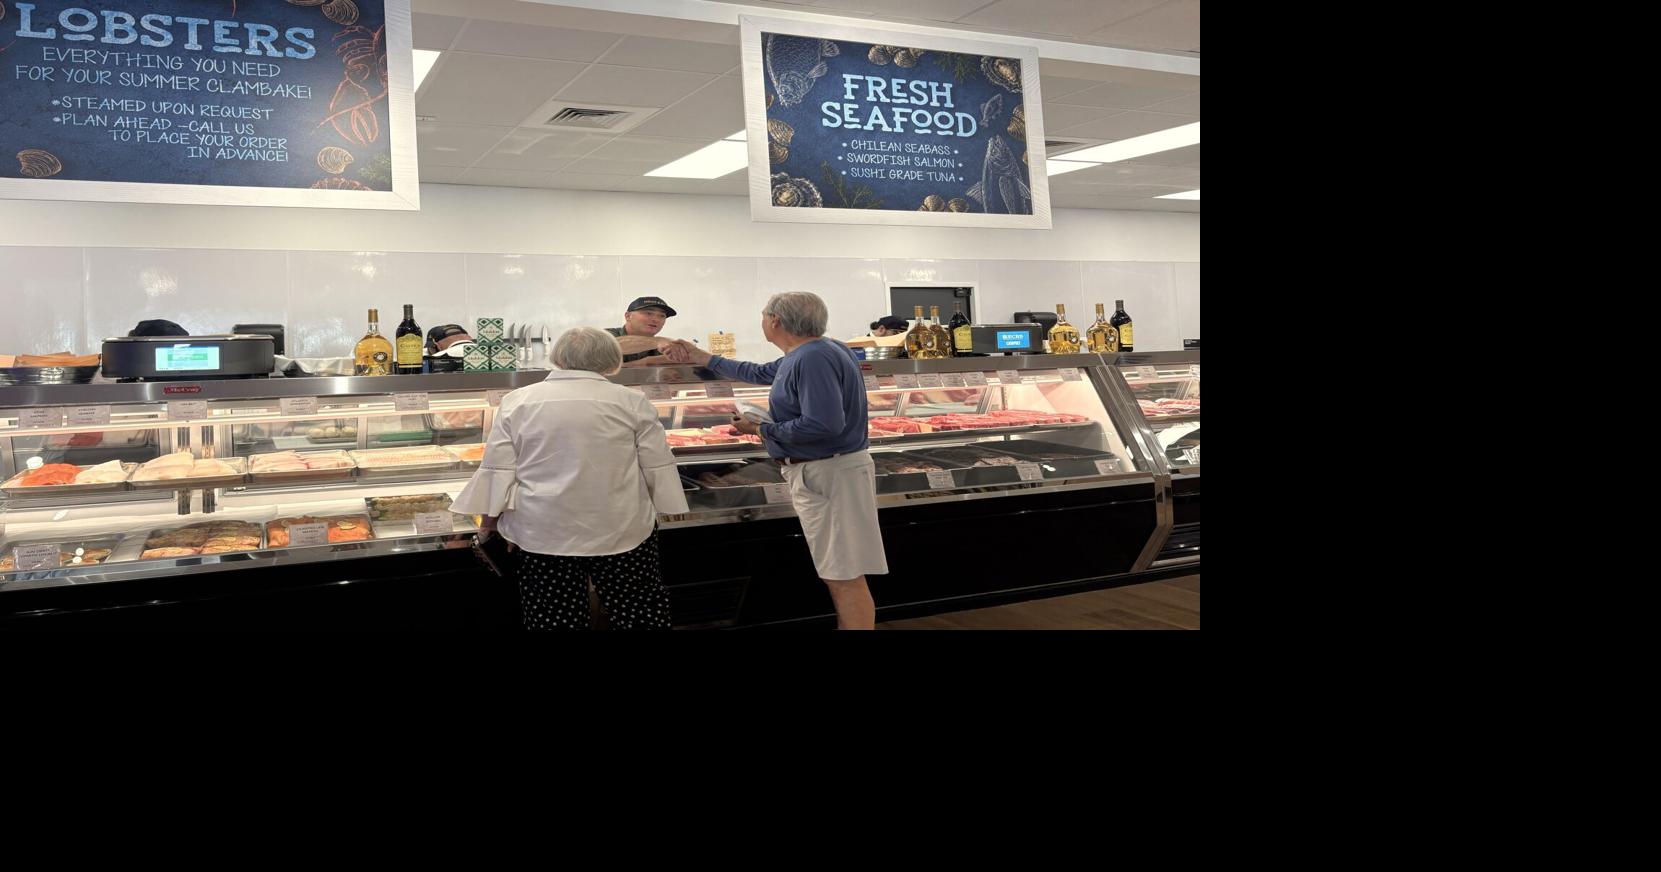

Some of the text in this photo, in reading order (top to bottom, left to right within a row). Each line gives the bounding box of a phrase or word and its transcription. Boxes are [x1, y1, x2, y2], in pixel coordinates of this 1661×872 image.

[16, 2, 318, 60] LOBSTERS
[43, 46, 281, 78] EVERYTHING YOU NEED
[16, 65, 312, 100] FOR YOUR SUMMER CLAMBAKE!
[842, 73, 954, 108] FRESH
[152, 100, 195, 115] UPON
[200, 104, 274, 120] REQUEST
[821, 101, 977, 138] SEAFOOD
[113, 116, 172, 130] AHEAD
[234, 122, 255, 135] US
[108, 129, 288, 150] TO PLACE YOUR ORDER
[851, 139, 951, 156] CHILEAN SEABASS
[187, 146, 289, 163] IN ADVANCE!
[846, 152, 956, 169] SWORDFISH SALMON
[850, 167, 956, 183] SUSHI GRADE TUNA
